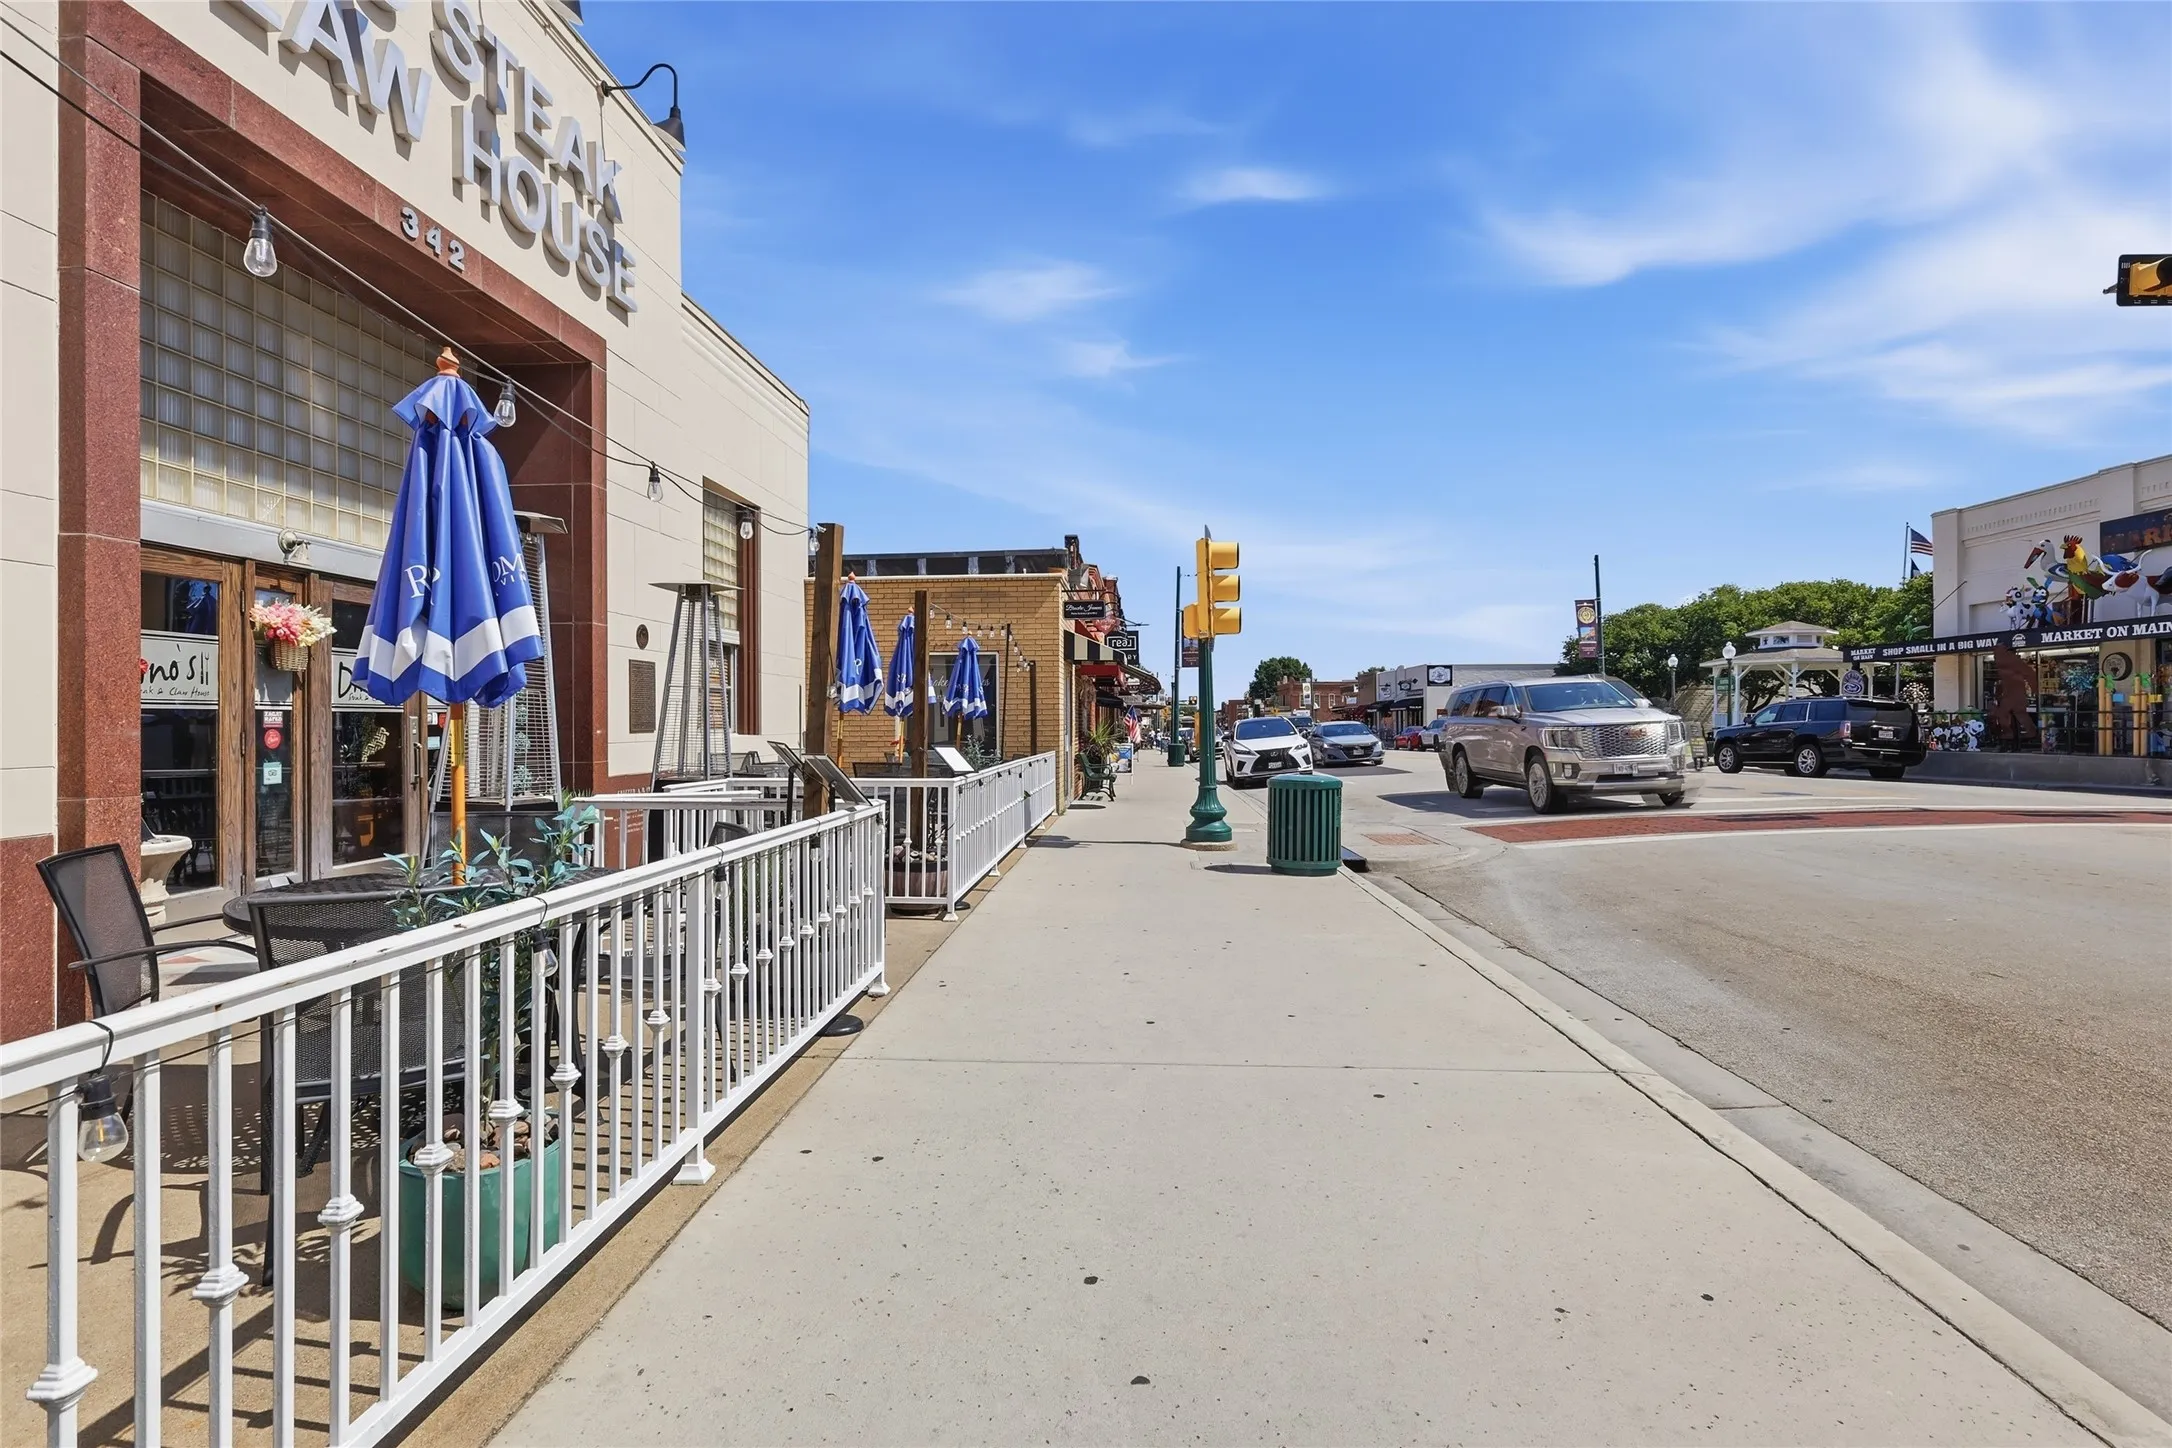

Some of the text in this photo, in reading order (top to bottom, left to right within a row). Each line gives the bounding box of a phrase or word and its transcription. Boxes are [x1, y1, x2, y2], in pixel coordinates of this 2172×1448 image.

[430, 0, 622, 223] STEAK
[400, 206, 465, 272] 342
[452, 105, 637, 313] HOUSE
[1882, 637, 1999, 657] SHOP SMALL IN A BIG WAY
[2040, 628, 2103, 643] MARKET
[2106, 625, 2130, 638] ON
